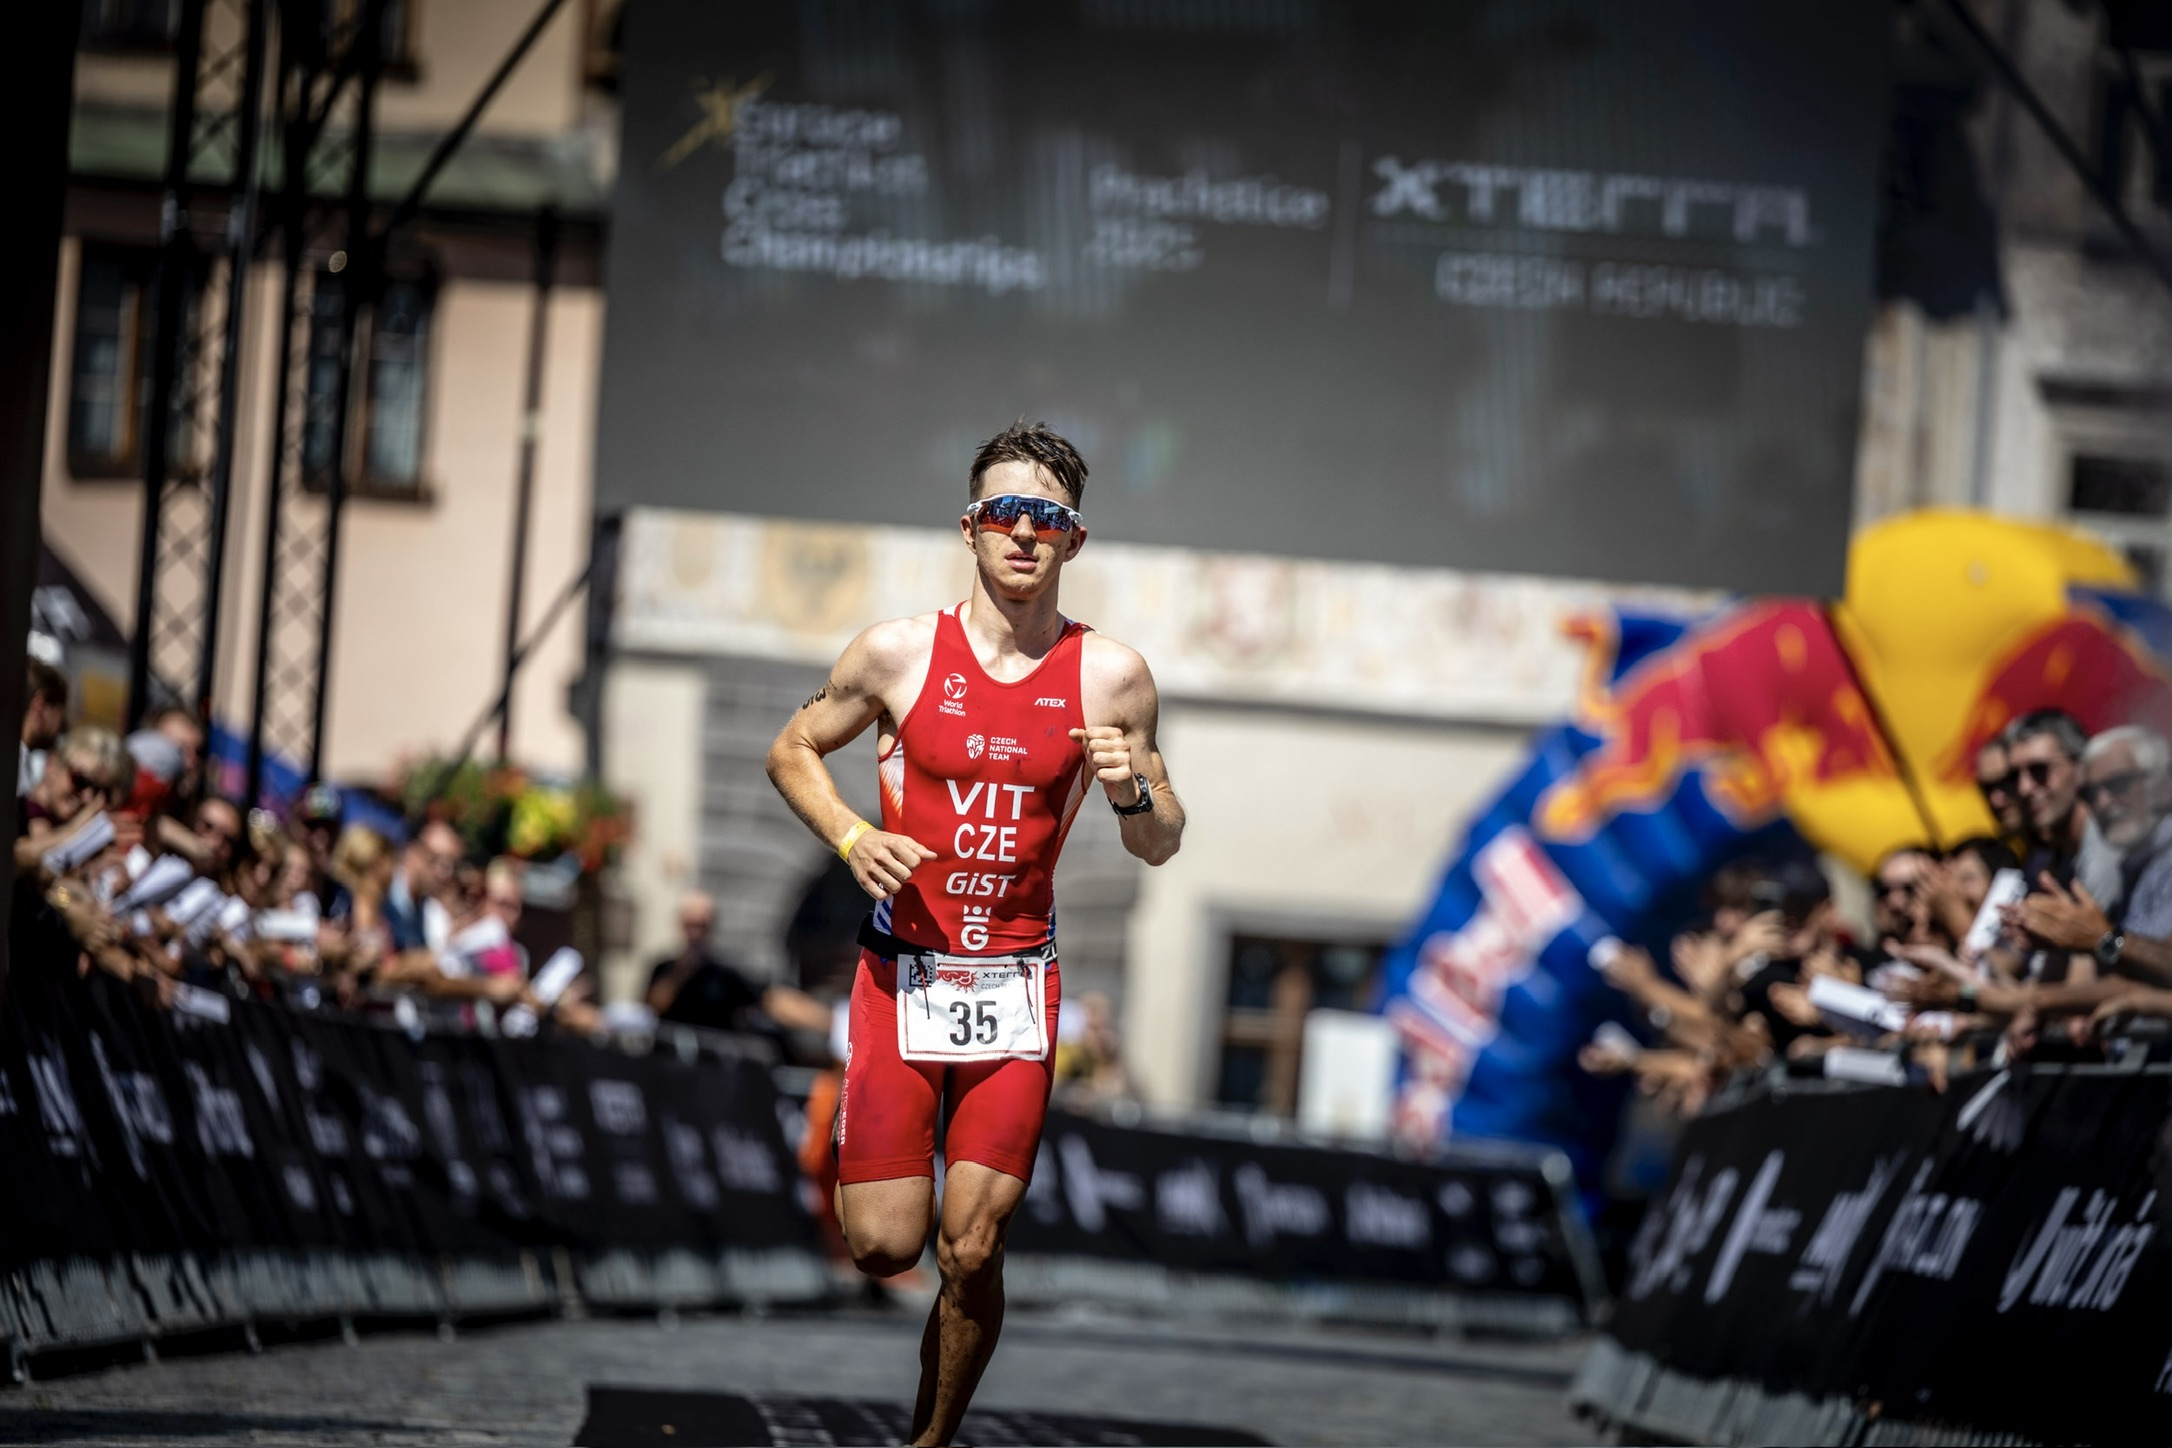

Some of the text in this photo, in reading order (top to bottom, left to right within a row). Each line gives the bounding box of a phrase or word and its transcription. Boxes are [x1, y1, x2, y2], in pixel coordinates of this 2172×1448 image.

[943, 699, 963, 710] World
[1034, 697, 1067, 708] ATEX
[938, 705, 966, 717] Triathlon
[990, 736, 1017, 746] CZECH
[989, 745, 1028, 755] NATIONAL
[988, 752, 1010, 761] TEAM
[945, 778, 1035, 820] VIT
[953, 822, 1018, 863] CZE
[982, 971, 1026, 979] XTERR
[949, 1000, 998, 1046] 35
